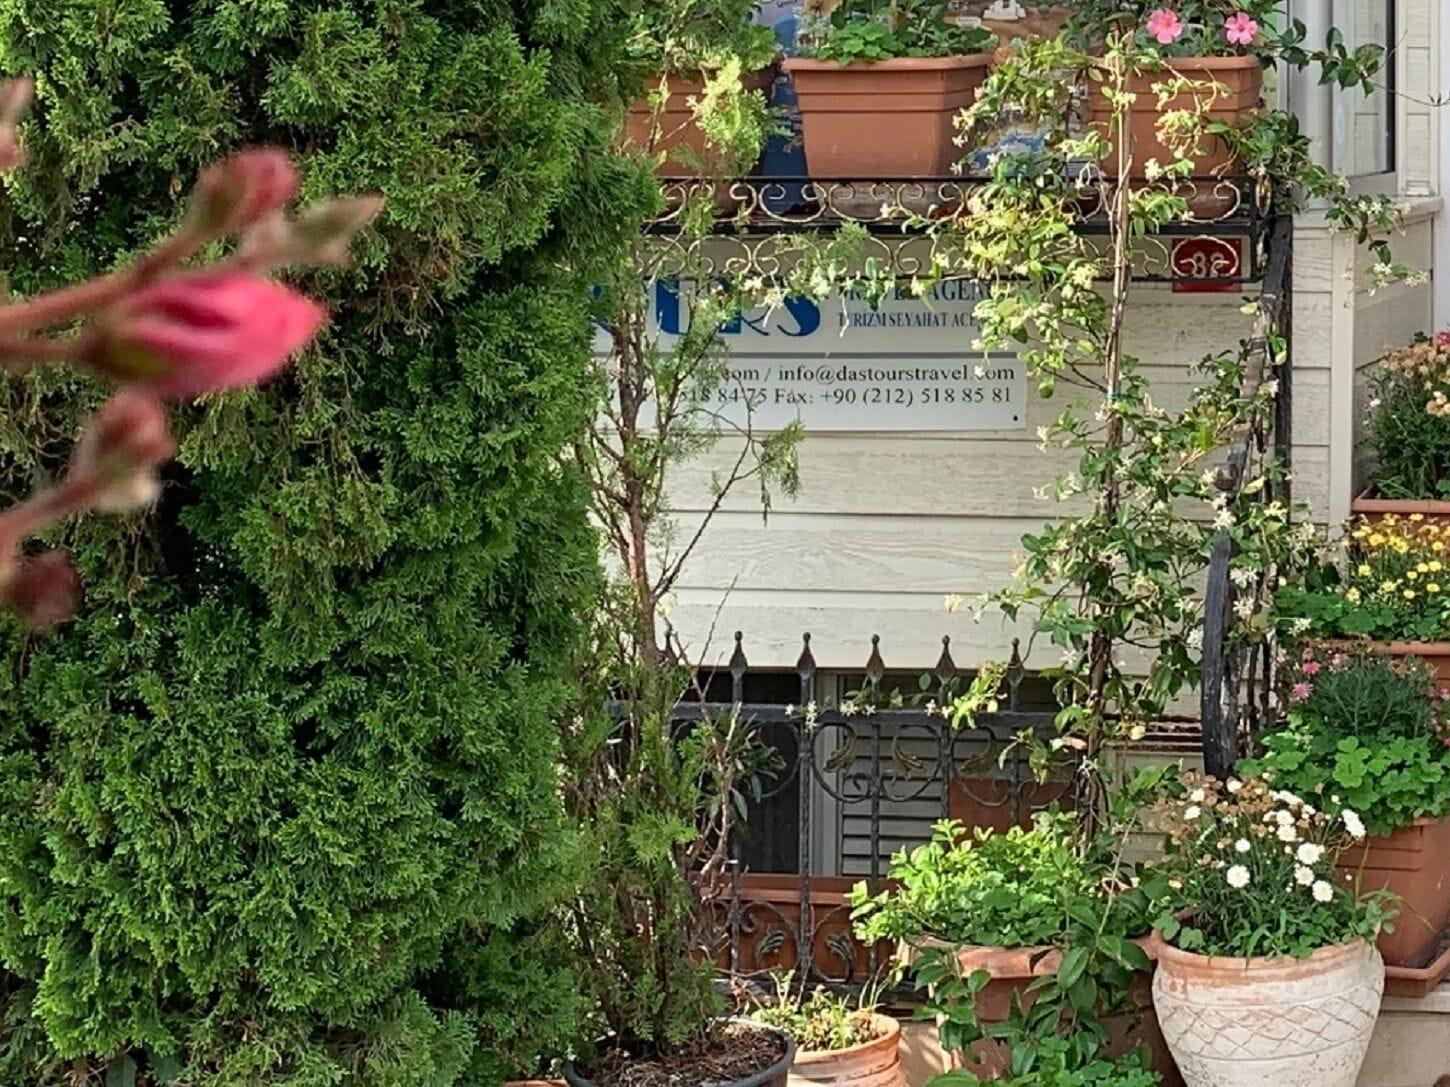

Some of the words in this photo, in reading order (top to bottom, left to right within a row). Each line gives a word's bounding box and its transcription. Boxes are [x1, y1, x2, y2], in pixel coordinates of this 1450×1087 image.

[774, 387, 814, 404] Fax:
[820, 387, 857, 404] +90
[862, 387, 914, 407] (212)
[921, 387, 955, 403] 518
[961, 387, 984, 403] 85
[992, 386, 1011, 403] 81
